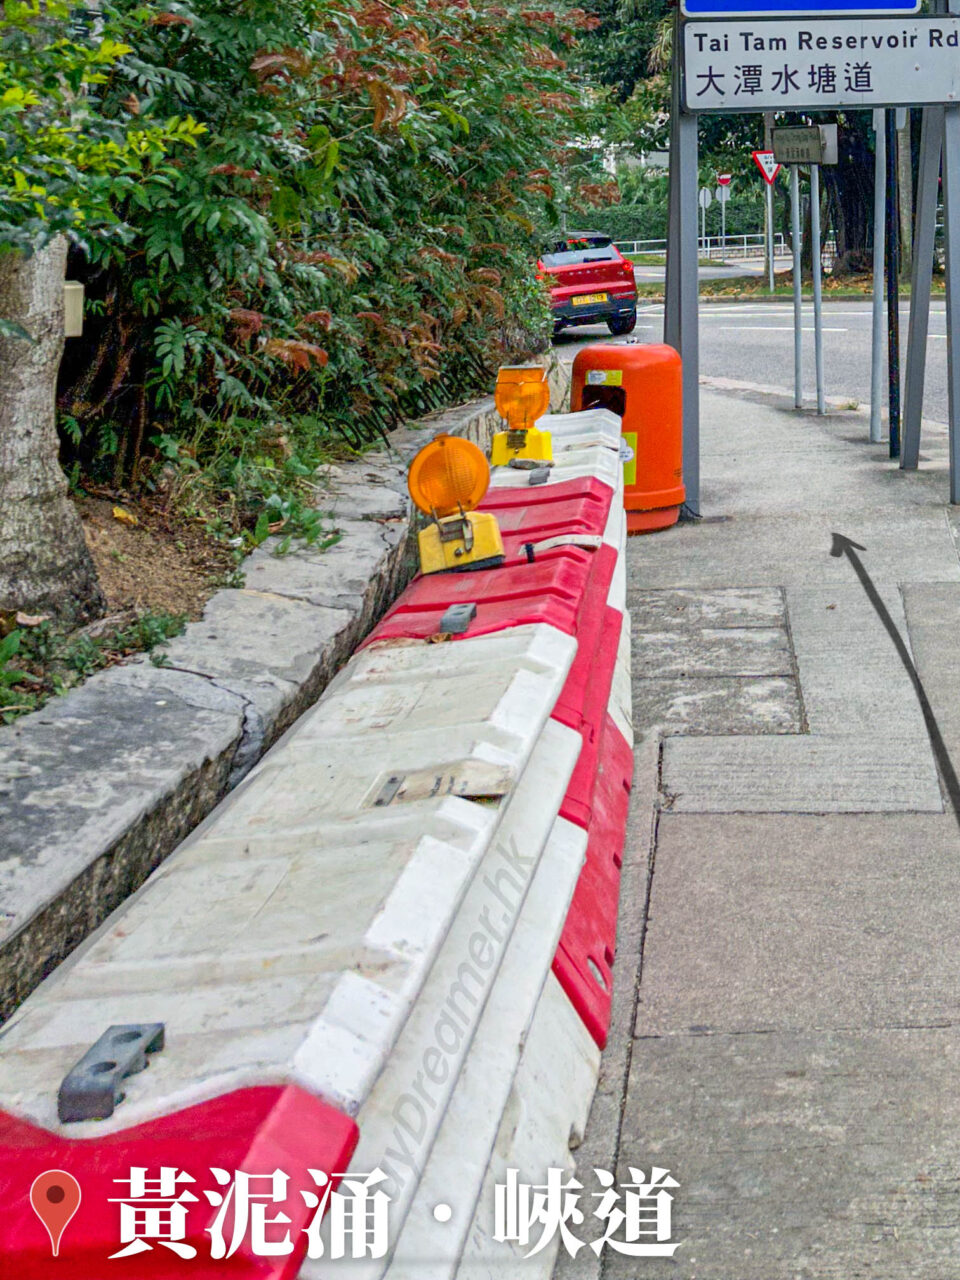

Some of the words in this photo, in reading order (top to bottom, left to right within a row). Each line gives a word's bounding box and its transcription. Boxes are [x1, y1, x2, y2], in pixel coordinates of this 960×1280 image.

[694, 32, 730, 53] Tai
[738, 31, 788, 52] Tam
[797, 30, 919, 51] Reservoir
[928, 28, 960, 49] Rd
[695, 61, 875, 97] 大潭水塘道
